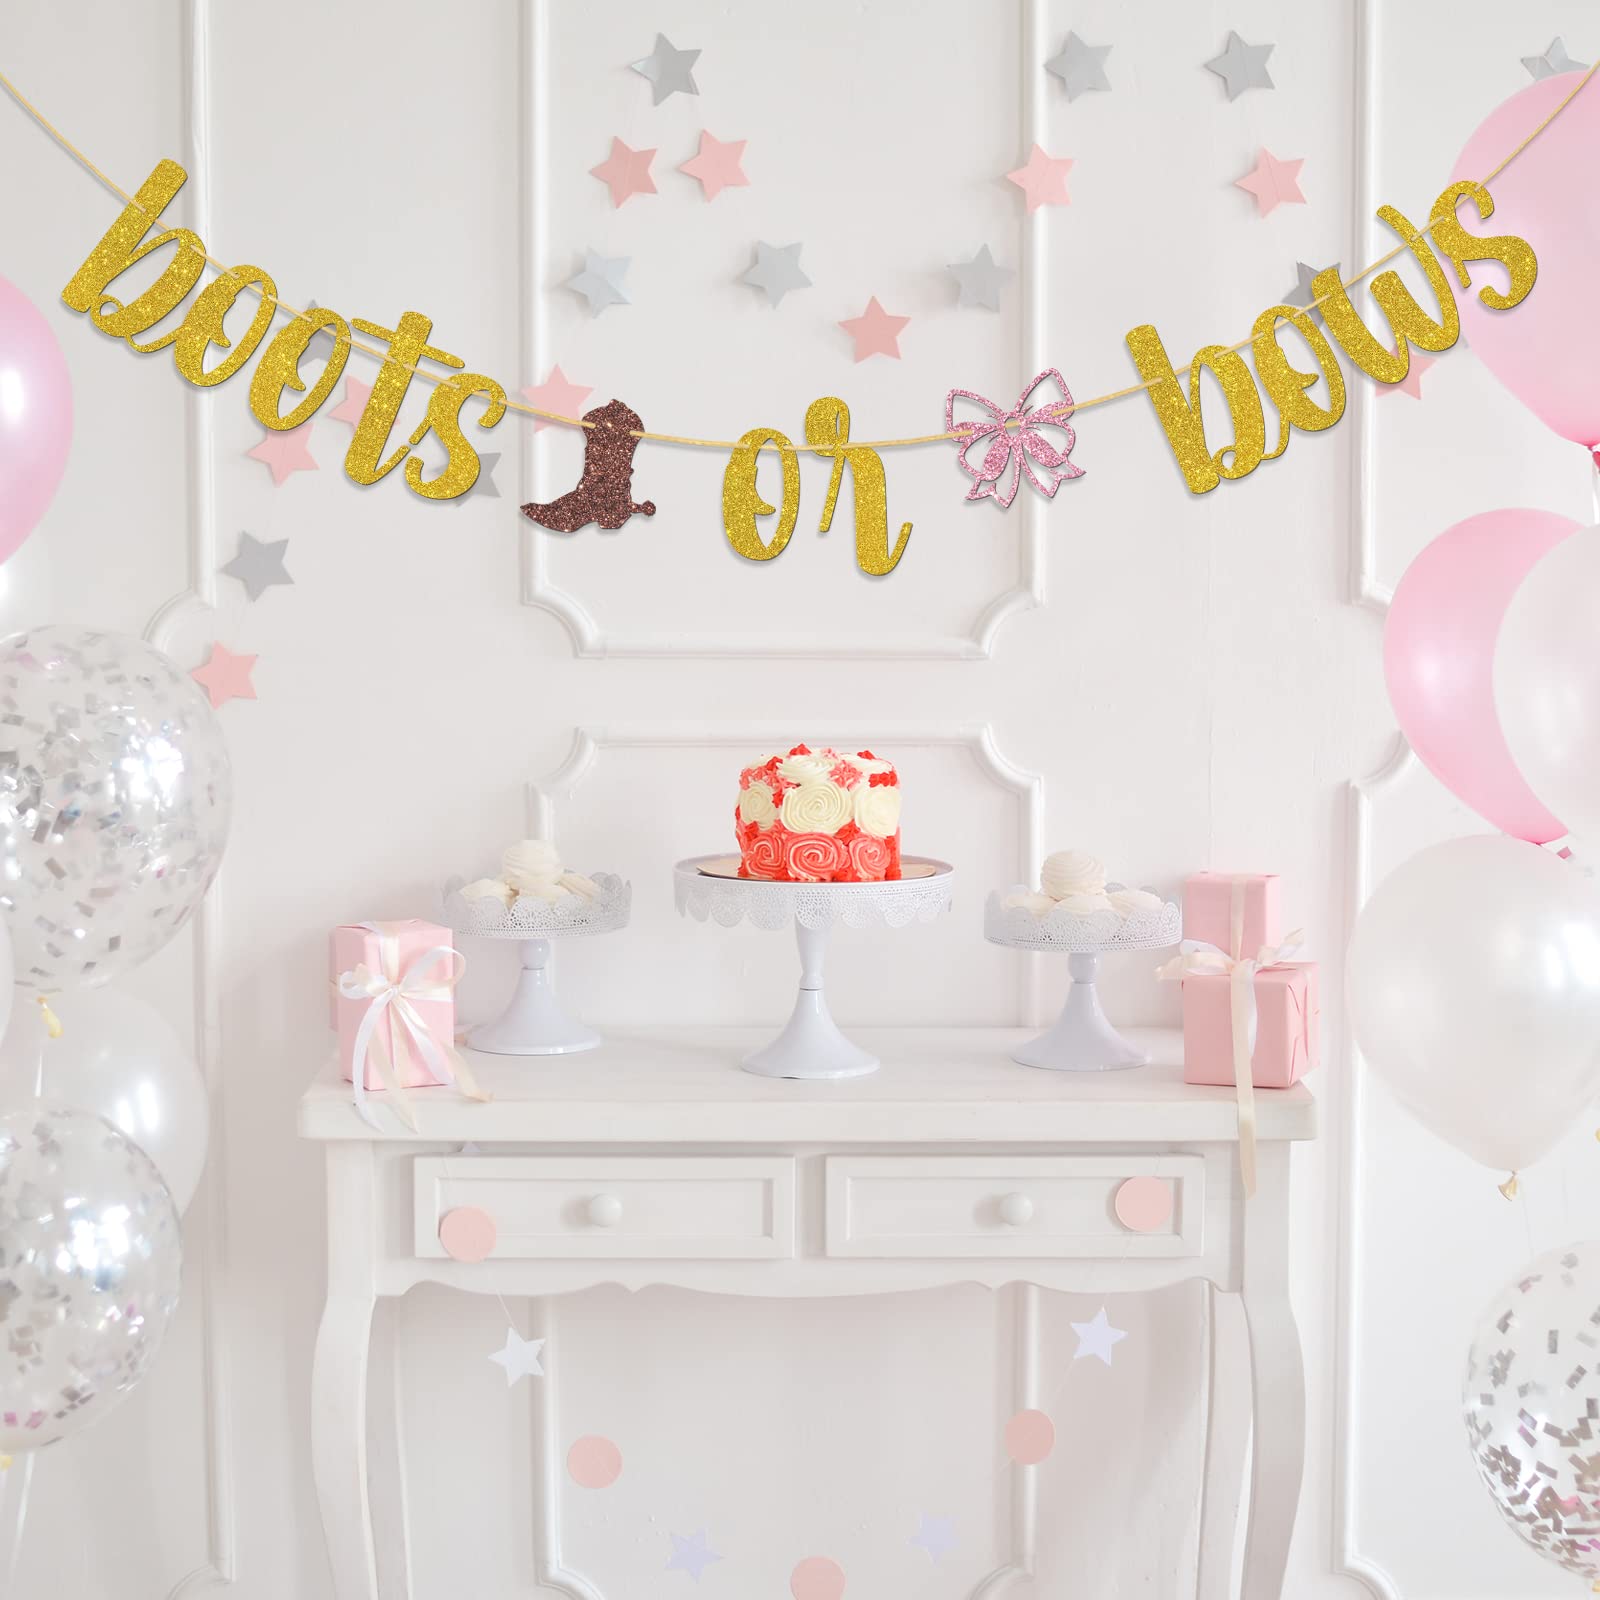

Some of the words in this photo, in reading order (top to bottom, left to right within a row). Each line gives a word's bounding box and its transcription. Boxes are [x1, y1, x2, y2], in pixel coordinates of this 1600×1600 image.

[61, 158, 507, 500] boots
[722, 396, 913, 577] or
[1125, 180, 1538, 495] bows
